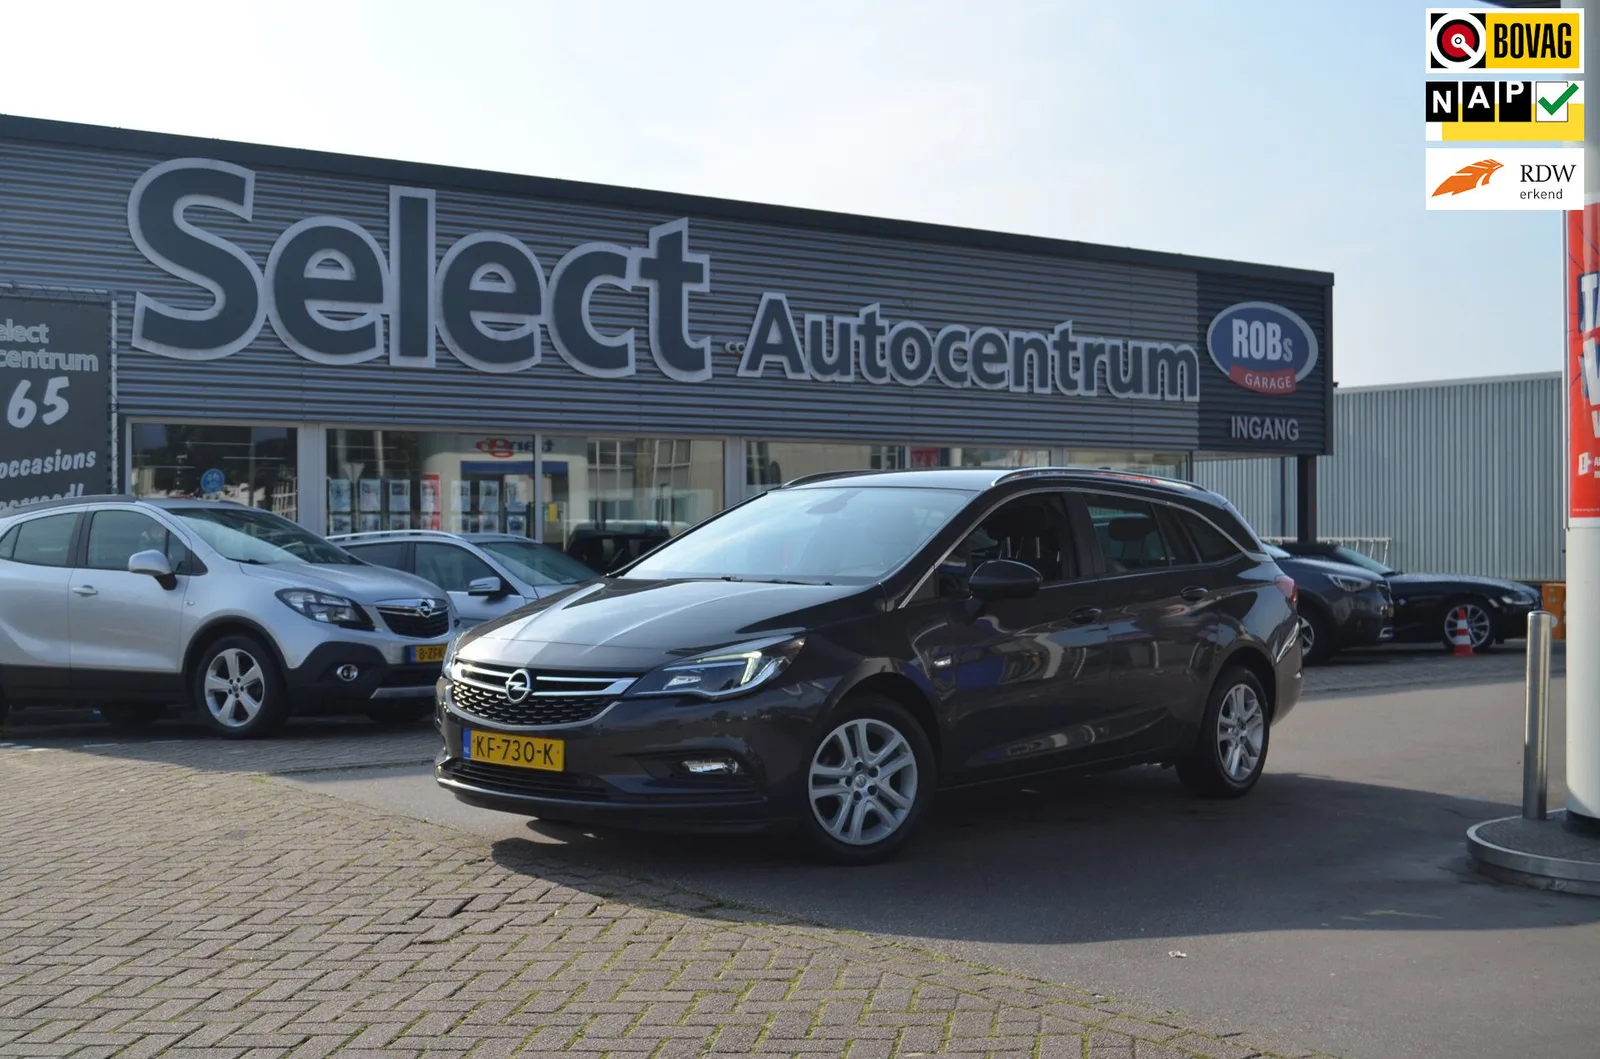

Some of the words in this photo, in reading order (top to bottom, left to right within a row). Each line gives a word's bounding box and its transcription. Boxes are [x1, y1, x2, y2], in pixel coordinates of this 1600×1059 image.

[127, 157, 712, 382] Select
[737, 292, 1199, 401] Autocentrum
[1232, 318, 1293, 363] ROBs
[1244, 373, 1293, 390] GARAGE
[7, 376, 70, 429] 65
[1231, 415, 1300, 442] INGANG
[476, 735, 554, 766] KF-730-K
